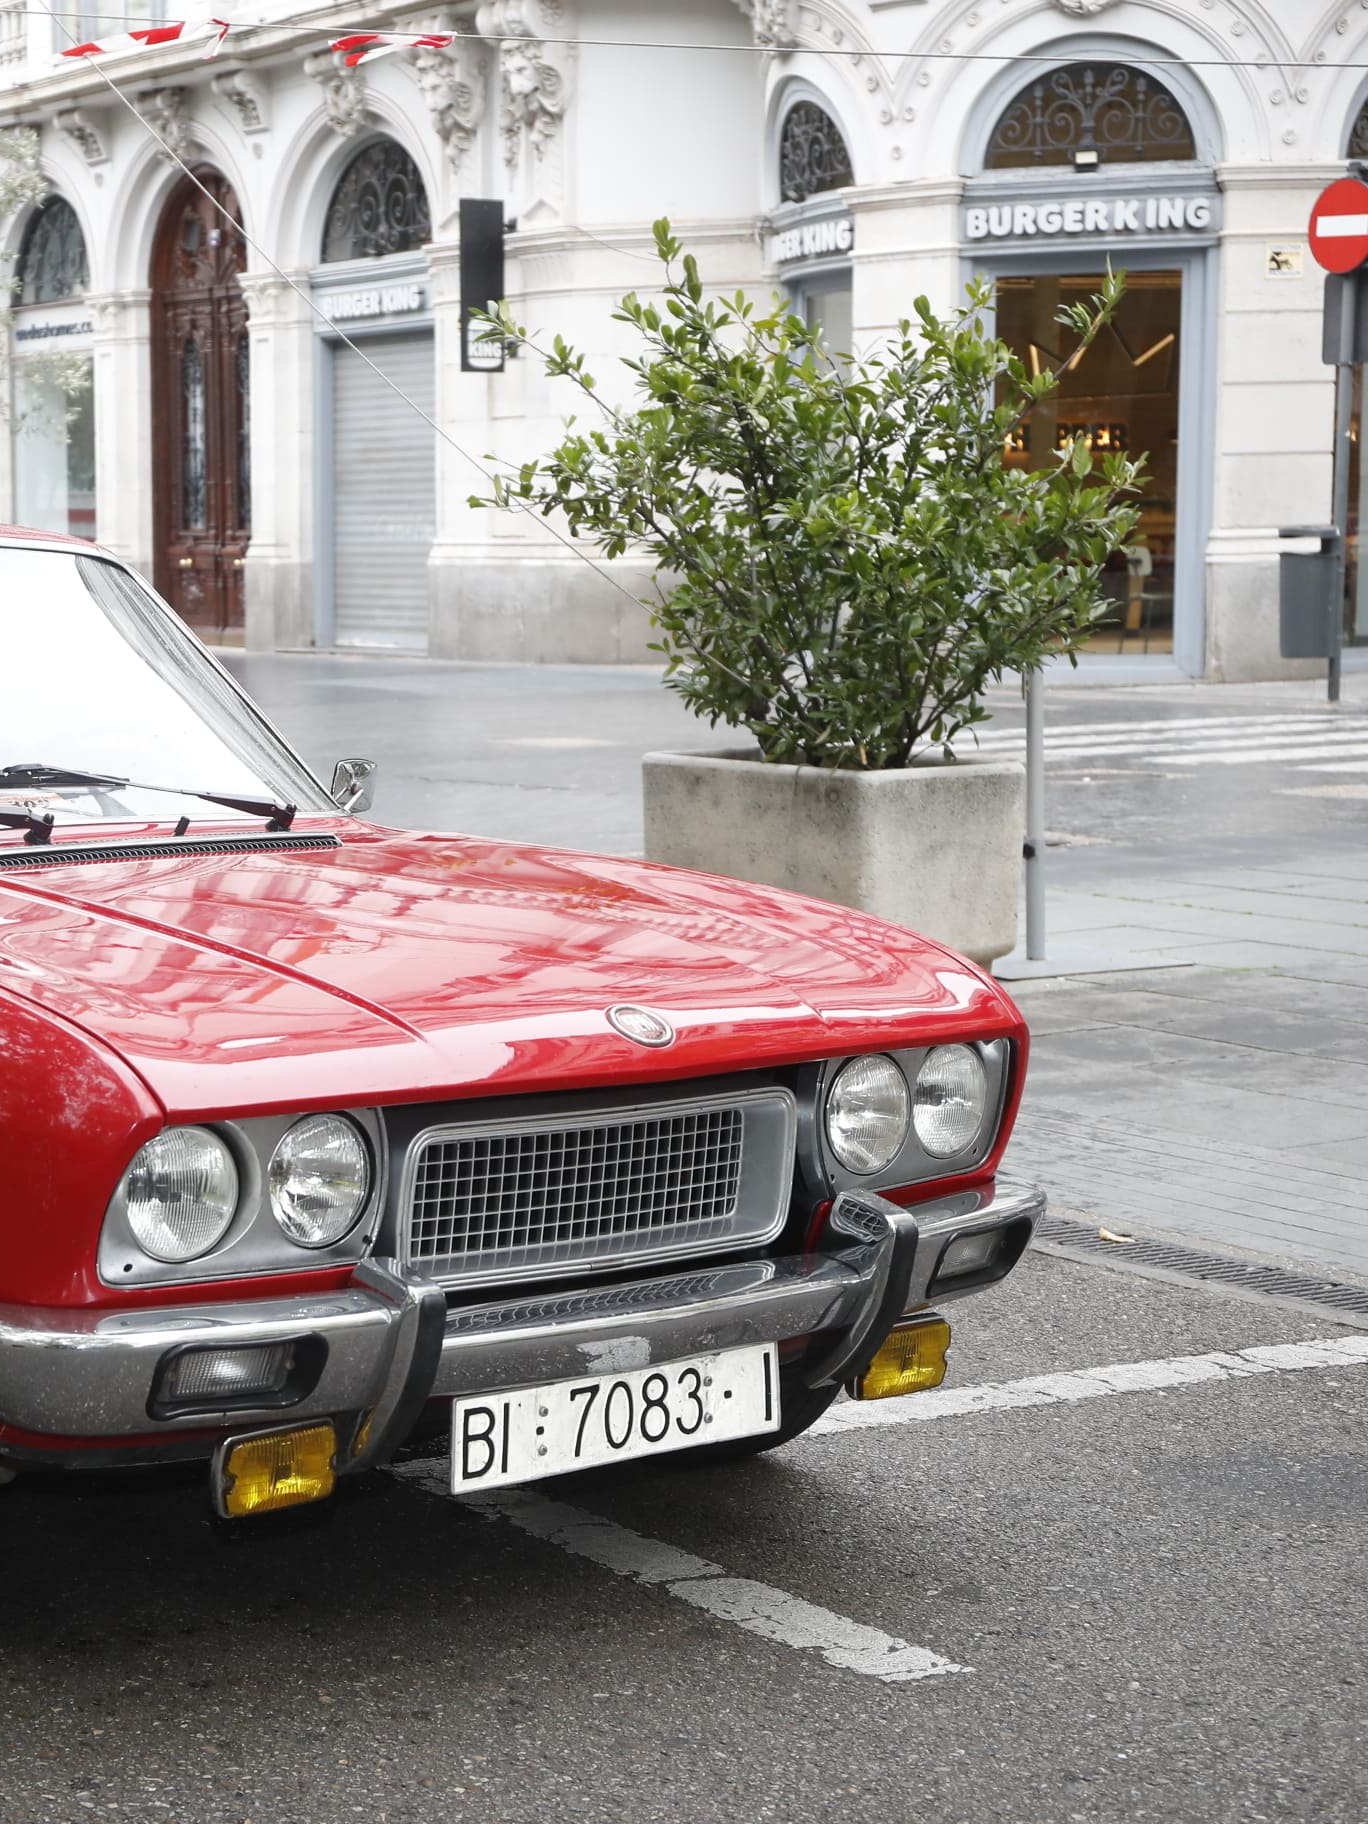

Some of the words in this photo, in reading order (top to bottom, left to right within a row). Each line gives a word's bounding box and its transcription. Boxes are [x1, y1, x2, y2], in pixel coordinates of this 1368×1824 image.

[966, 201, 1109, 240] BURGER
[1113, 197, 1211, 231] KING
[803, 220, 852, 255] KING
[318, 290, 380, 320] BURGER
[381, 284, 421, 313] KING
[471, 341, 503, 357] KING
[569, 1367, 704, 1458] 7083
